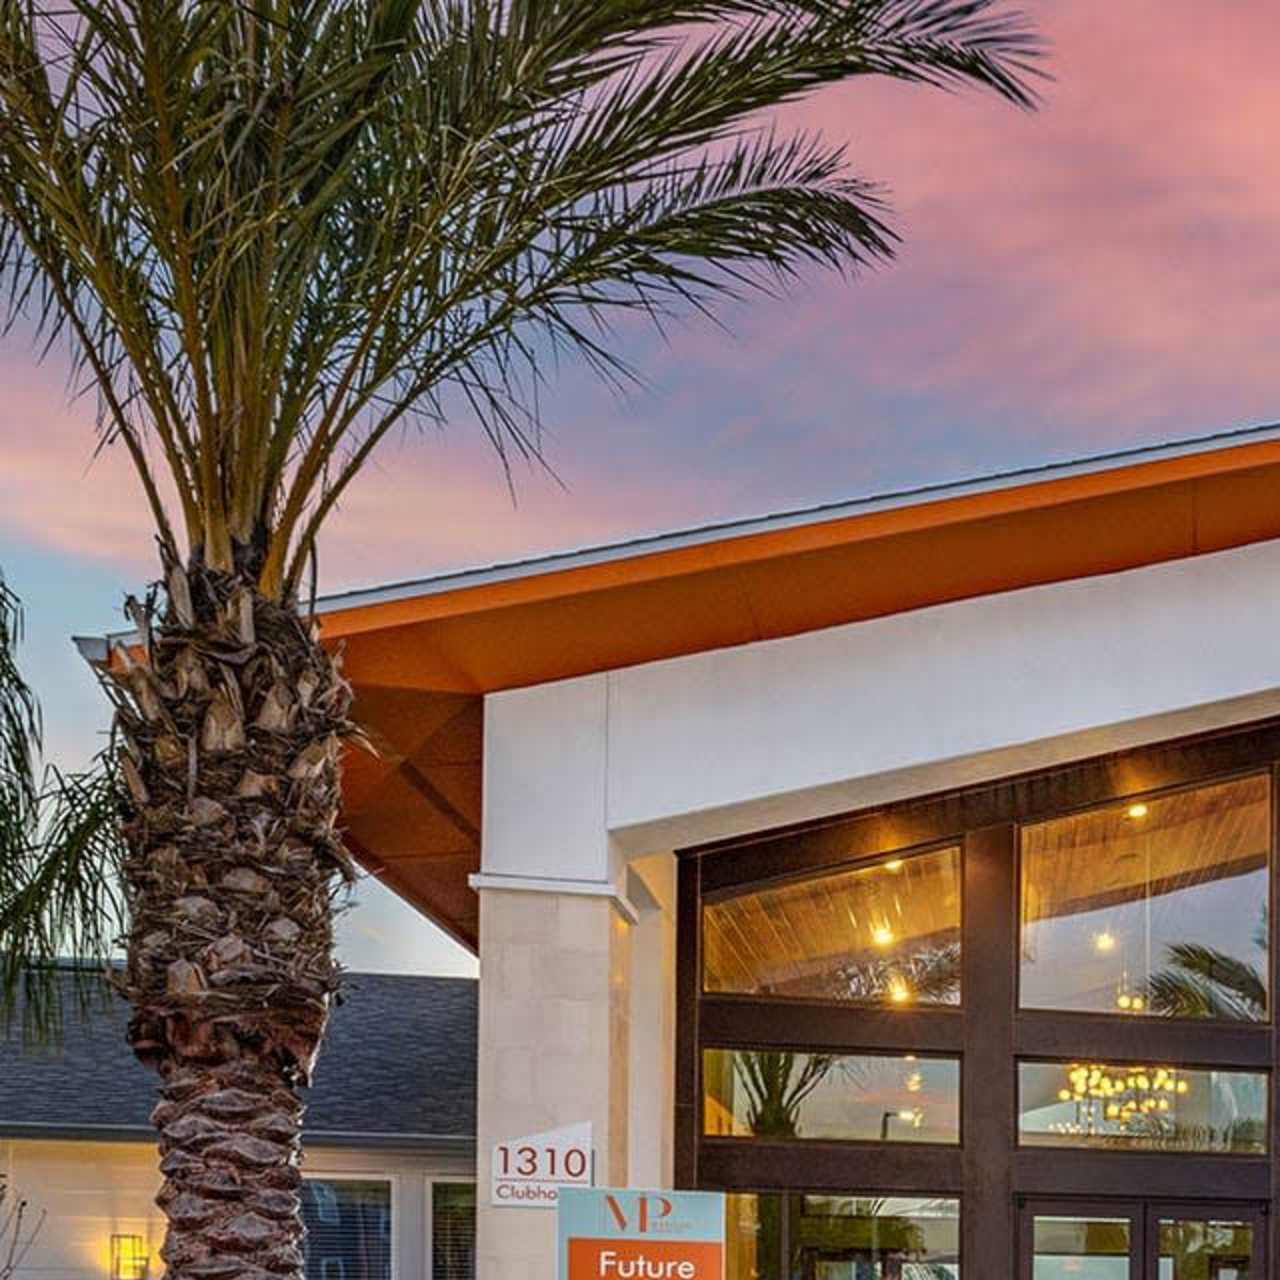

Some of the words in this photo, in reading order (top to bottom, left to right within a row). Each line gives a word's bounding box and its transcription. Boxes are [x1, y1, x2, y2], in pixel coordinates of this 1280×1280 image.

[498, 1146, 587, 1177] 1310
[495, 1184, 558, 1200] Clubho
[600, 1251, 695, 1279] Future
